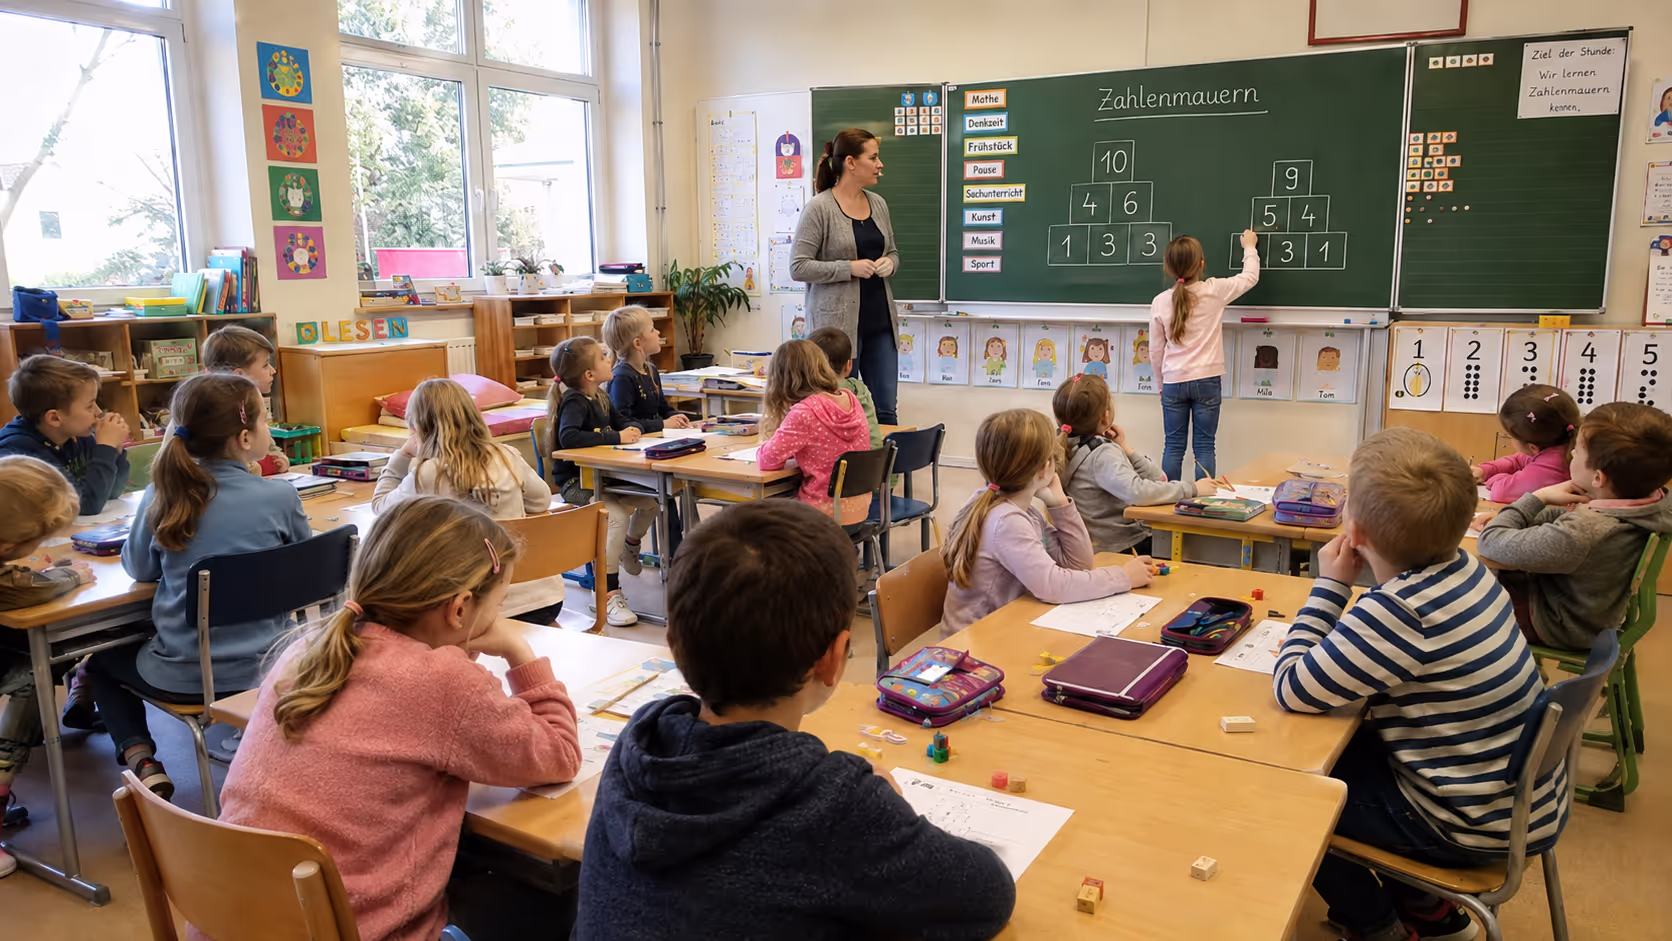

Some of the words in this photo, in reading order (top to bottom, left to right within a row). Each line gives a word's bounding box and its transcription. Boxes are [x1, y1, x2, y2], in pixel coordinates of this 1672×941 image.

[1532, 49, 1552, 60] Ziel
[1559, 48, 1575, 58] der
[1580, 46, 1615, 56] Stunde:
[1539, 70, 1556, 79] Wir
[1562, 68, 1597, 78] lernen
[1097, 85, 1260, 111] Zahlenmauern
[1529, 86, 1610, 97] Zahlenmauern
[971, 94, 999, 104] Mathe
[1549, 102, 1581, 112] kennen.
[968, 118, 1004, 128] Denkzeit
[968, 140, 1013, 152] Frühstück
[1100, 149, 1127, 174] 10
[973, 165, 997, 174] Pause
[1285, 166, 1299, 190] 9
[966, 188, 1023, 198] Sachunterricht
[1082, 192, 1098, 216] 4
[1123, 191, 1138, 215] 6
[971, 212, 996, 221] Kunst
[1262, 204, 1277, 227] 5
[1301, 204, 1316, 227] 4
[971, 236, 996, 245] Musik
[1061, 234, 1071, 258] 1
[1100, 233, 1116, 257] 3
[1141, 232, 1157, 257] 3
[1280, 240, 1294, 263] 3
[1318, 240, 1329, 262] 1
[971, 259, 995, 270] Sport
[1413, 339, 1425, 359] 1
[1466, 340, 1481, 361] 2
[1523, 341, 1538, 362] 3
[1581, 341, 1597, 364] 4
[1642, 343, 1658, 365] 5
[1319, 390, 1335, 398] Tom
